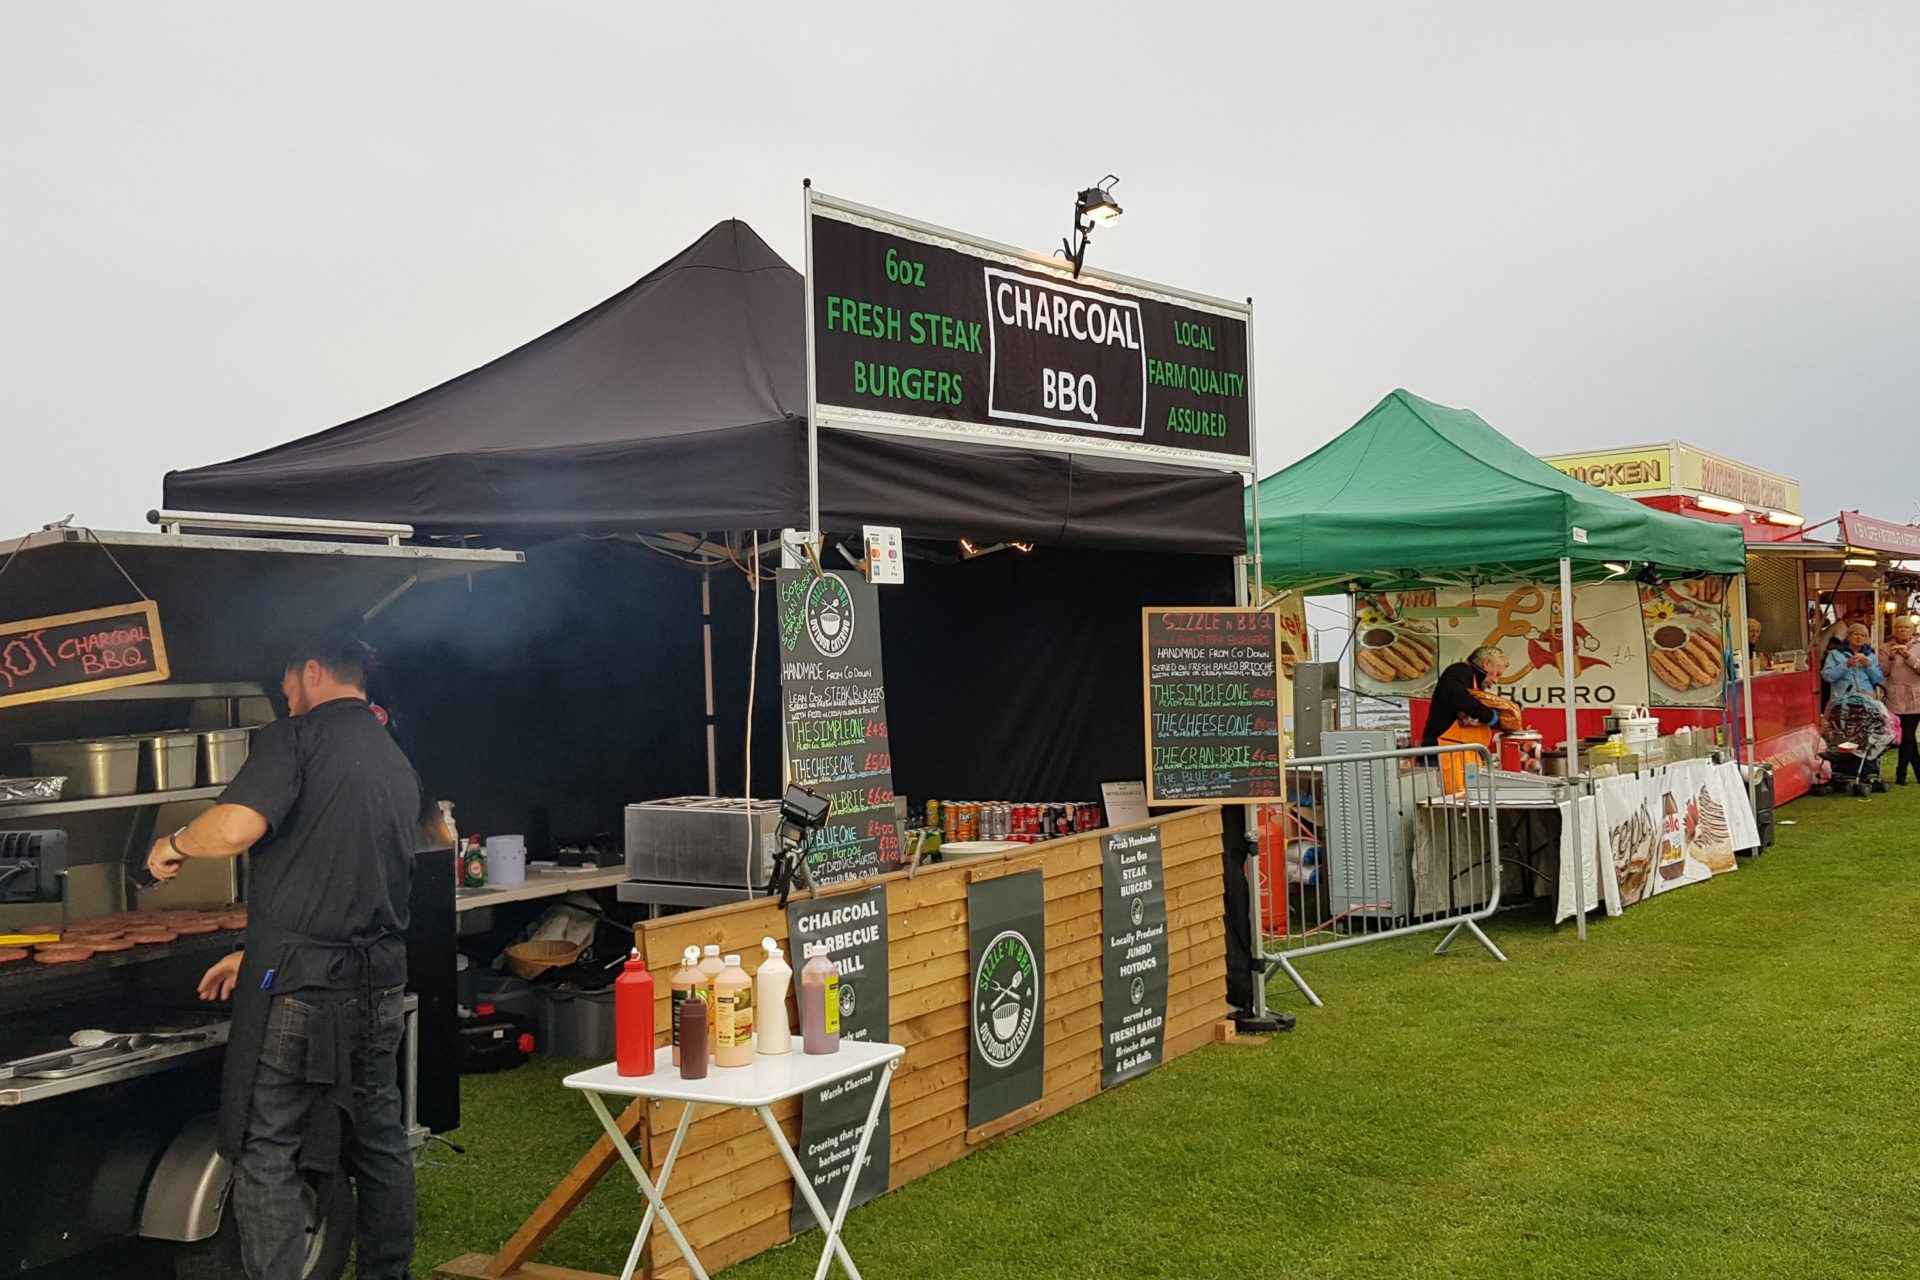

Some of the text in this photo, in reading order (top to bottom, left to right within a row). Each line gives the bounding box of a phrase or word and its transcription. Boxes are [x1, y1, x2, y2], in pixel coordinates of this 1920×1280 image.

[885, 248, 926, 288] 6oz
[826, 296, 984, 355] FRESH STEAK
[996, 282, 1140, 350] CHARCOAL
[1173, 319, 1216, 352] LOCAL
[854, 360, 963, 406] BURGERS
[1148, 359, 1244, 398] FARM QUALITY
[1042, 367, 1099, 422] BBQ
[1166, 406, 1227, 438] ASSURED
[1564, 459, 1661, 487] ICKEN
[1162, 613, 1220, 630] SIZZLE
[1238, 613, 1273, 631] BBQ
[58, 626, 151, 659] CHARCOAL
[1157, 647, 1205, 659] HANDMADE
[1209, 648, 1229, 659] FROM
[0, 630, 56, 688] OT
[82, 647, 147, 675] BBQ
[1188, 663, 1211, 672] FRESH
[1213, 662, 1238, 671] BAKED
[1239, 661, 1274, 672] BRIOCHE
[782, 661, 824, 680] HANDMADE
[788, 690, 808, 704] LEAN
[824, 685, 851, 701] STEAK
[1151, 683, 1176, 702] THE
[1176, 683, 1224, 701] SIMPLE
[1225, 683, 1250, 700] ONE
[1497, 685, 1616, 704] HURRO
[787, 719, 811, 742] THE
[813, 718, 849, 741] SIMPLE
[849, 718, 866, 738] ONE
[1152, 713, 1177, 732] THE
[1177, 713, 1226, 732] CHEESE
[1226, 713, 1254, 734] ONE
[1152, 746, 1179, 764] THE
[791, 758, 811, 779] THE
[811, 755, 839, 777] CHEESE
[839, 754, 856, 775] ONE
[1155, 772, 1176, 785] THE
[1181, 770, 1209, 782] BLUE
[1210, 770, 1232, 781] ONE
[827, 788, 865, 811] AN-BRIE
[839, 825, 857, 842] ONE
[1108, 838, 1129, 851] Fresh
[807, 851, 829, 864] UMBO
[811, 864, 826, 878] OFT
[826, 857, 855, 873] DRINKS
[1120, 854, 1137, 865] Lean
[1122, 865, 1148, 880] STEAK
[1120, 879, 1153, 897] BURGERS
[798, 900, 879, 933] CHARCOAL
[1110, 923, 1164, 947] Locally Produced
[1125, 942, 1152, 959] JUMBO
[832, 954, 865, 977] RILL
[980, 941, 1004, 991] SIZZLE
[1016, 945, 1031, 979] BBQ
[1119, 956, 1158, 977] HOTDOGS
[855, 1028, 868, 1039] use
[980, 1007, 1032, 1059] OUTDOOR CATERING
[1109, 1015, 1163, 1045] FRESH BAKED
[1122, 1055, 1136, 1070] Sub
[1136, 1050, 1152, 1064] Rolls
[844, 1070, 874, 1092] Charcoal
[808, 1135, 839, 1156] Creating
[839, 1128, 854, 1142] that
[818, 1147, 851, 1168] barbecue
[814, 1163, 851, 1187] for you to
